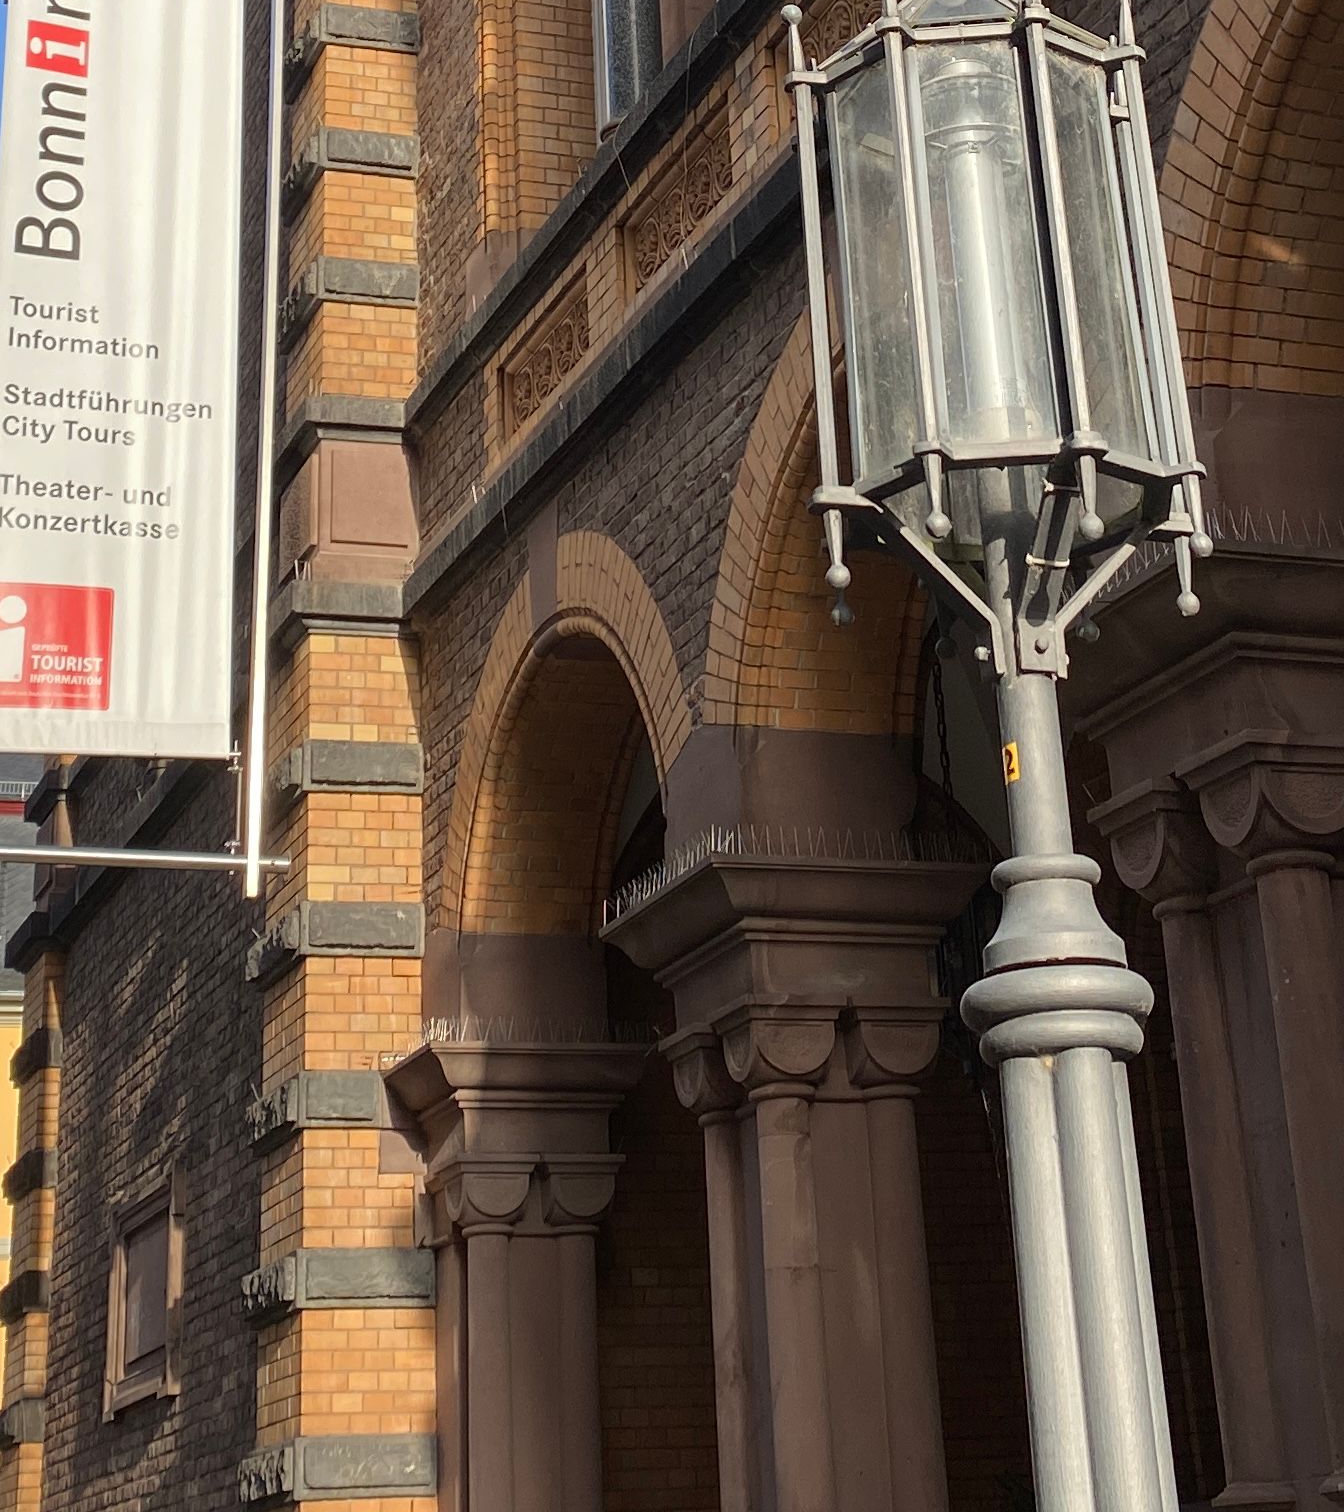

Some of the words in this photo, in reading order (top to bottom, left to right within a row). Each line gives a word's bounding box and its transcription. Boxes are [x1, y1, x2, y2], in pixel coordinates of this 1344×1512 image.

[9, 295, 100, 324] Tourist
[8, 327, 159, 360] Information
[3, 383, 212, 423] Stadtführungen
[2, 415, 56, 444] City
[63, 420, 136, 446] Tours
[123, 486, 171, 507] und
[31, 654, 104, 673] TOURIST
[29, 673, 102, 686] INFORMATION
